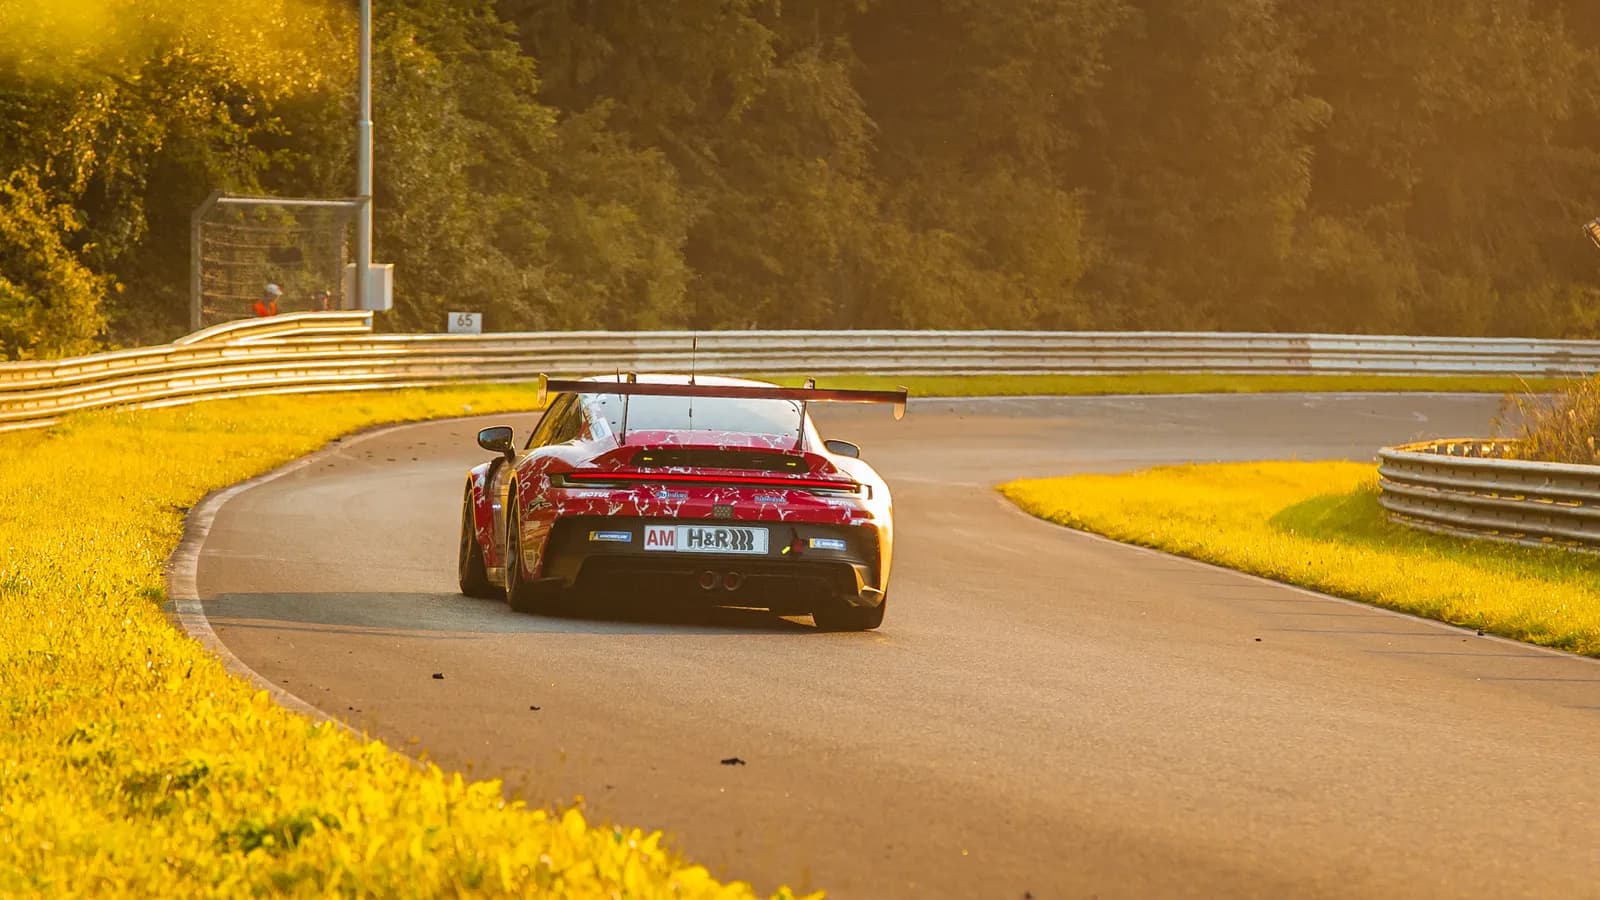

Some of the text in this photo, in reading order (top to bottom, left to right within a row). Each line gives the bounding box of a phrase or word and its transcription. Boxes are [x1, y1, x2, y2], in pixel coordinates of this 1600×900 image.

[457, 314, 473, 327] 65
[646, 528, 730, 548] AM H&R
